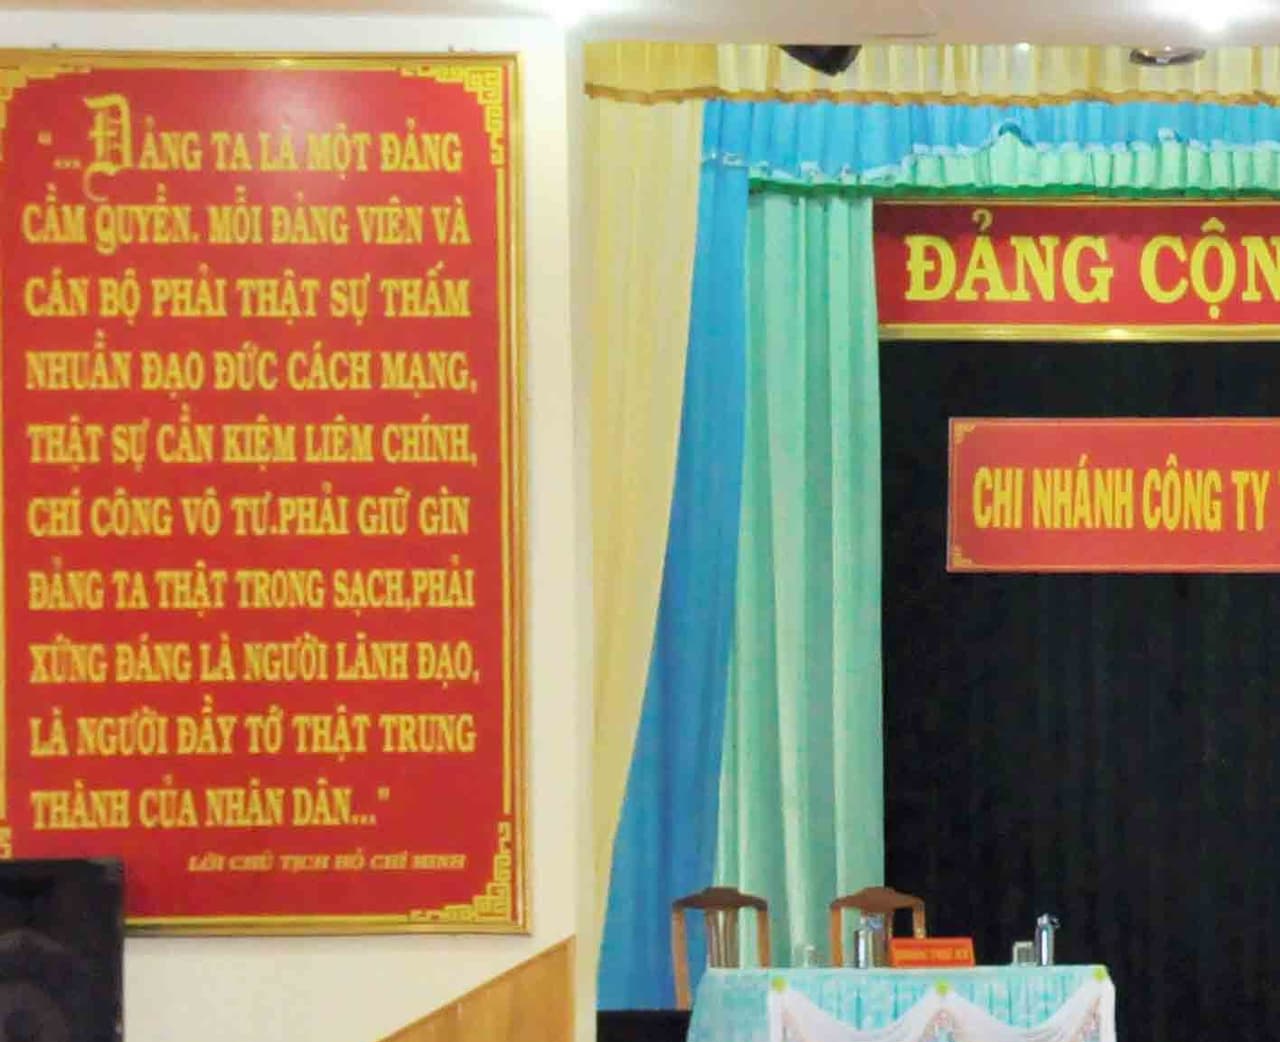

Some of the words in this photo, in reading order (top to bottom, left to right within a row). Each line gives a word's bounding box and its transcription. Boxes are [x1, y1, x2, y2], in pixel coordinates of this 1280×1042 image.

[211, 132, 252, 171] TA
[307, 123, 371, 180] MỘT
[380, 118, 463, 172] ĐẢNG
[271, 192, 350, 244] ĐẢNG
[357, 195, 422, 245] VIÊN
[432, 195, 470, 244] VÀ
[905, 210, 1114, 303] ĐẢNG
[99, 267, 141, 325] BỘ
[153, 263, 227, 316] PHẢI
[237, 268, 321, 325] THẬT
[330, 273, 370, 326] SỰ
[382, 261, 470, 316] THẤM
[142, 352, 205, 398] ĐẠO
[214, 340, 278, 390] ĐỨC
[287, 341, 371, 390] CÁCH
[381, 352, 478, 398] MẠNG,
[27, 414, 103, 472] THẬT
[112, 417, 150, 472] SỰ
[223, 413, 297, 472] KIỆM
[305, 414, 374, 463] LIÊM
[382, 413, 478, 466] CHÍNH,
[27, 486, 82, 536] CHÍ
[90, 487, 173, 536] CÔNG
[181, 486, 221, 535] VÔ
[358, 487, 411, 535] GIỮ
[419, 486, 470, 535] GÌN
[973, 468, 1024, 531] CHI
[1032, 454, 1133, 531] NHÁNH
[1142, 455, 1221, 532] CÔNG
[1231, 469, 1269, 530] TY
[28, 556, 103, 611] ĐẢNG
[112, 571, 149, 610] TA
[155, 559, 227, 618] THẬT
[234, 569, 325, 609] TRONG
[115, 632, 192, 683] ĐÁNG
[202, 632, 235, 682] LÀ
[243, 632, 328, 680] NGƯỜI
[336, 633, 409, 681] LÃNH
[417, 642, 480, 689] ĐẠO,
[30, 707, 69, 757] LÀ
[77, 706, 168, 756] NGƯỜI
[293, 704, 371, 762] THẬT
[379, 715, 477, 754] TRUNG
[31, 780, 130, 830] THÀNH
[139, 775, 197, 828] CỦA
[205, 778, 285, 827] NHÂN
